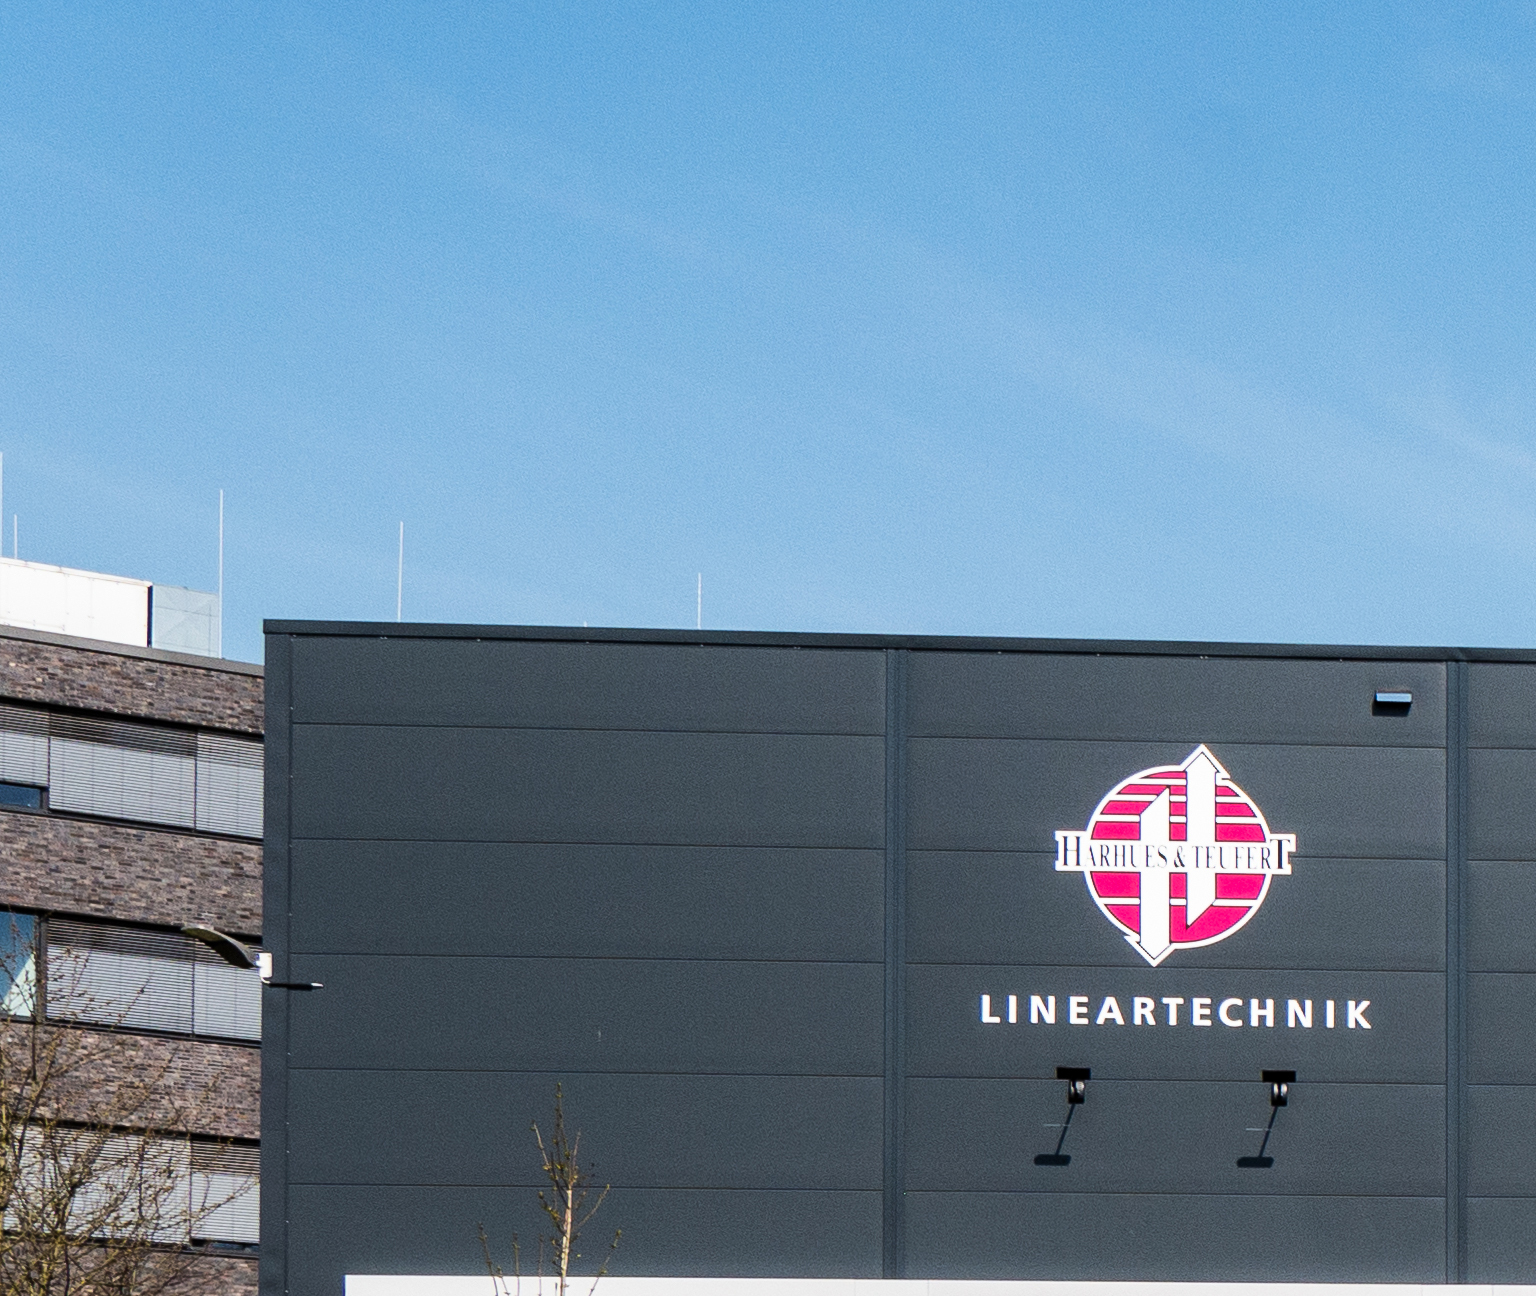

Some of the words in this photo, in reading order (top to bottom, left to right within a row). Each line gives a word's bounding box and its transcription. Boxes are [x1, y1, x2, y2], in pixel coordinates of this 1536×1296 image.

[1061, 835, 1168, 868] HARHUES
[1173, 845, 1187, 868] &
[1191, 838, 1291, 870] TEUFERT
[979, 994, 1373, 1030] LINEARTECHNIK
